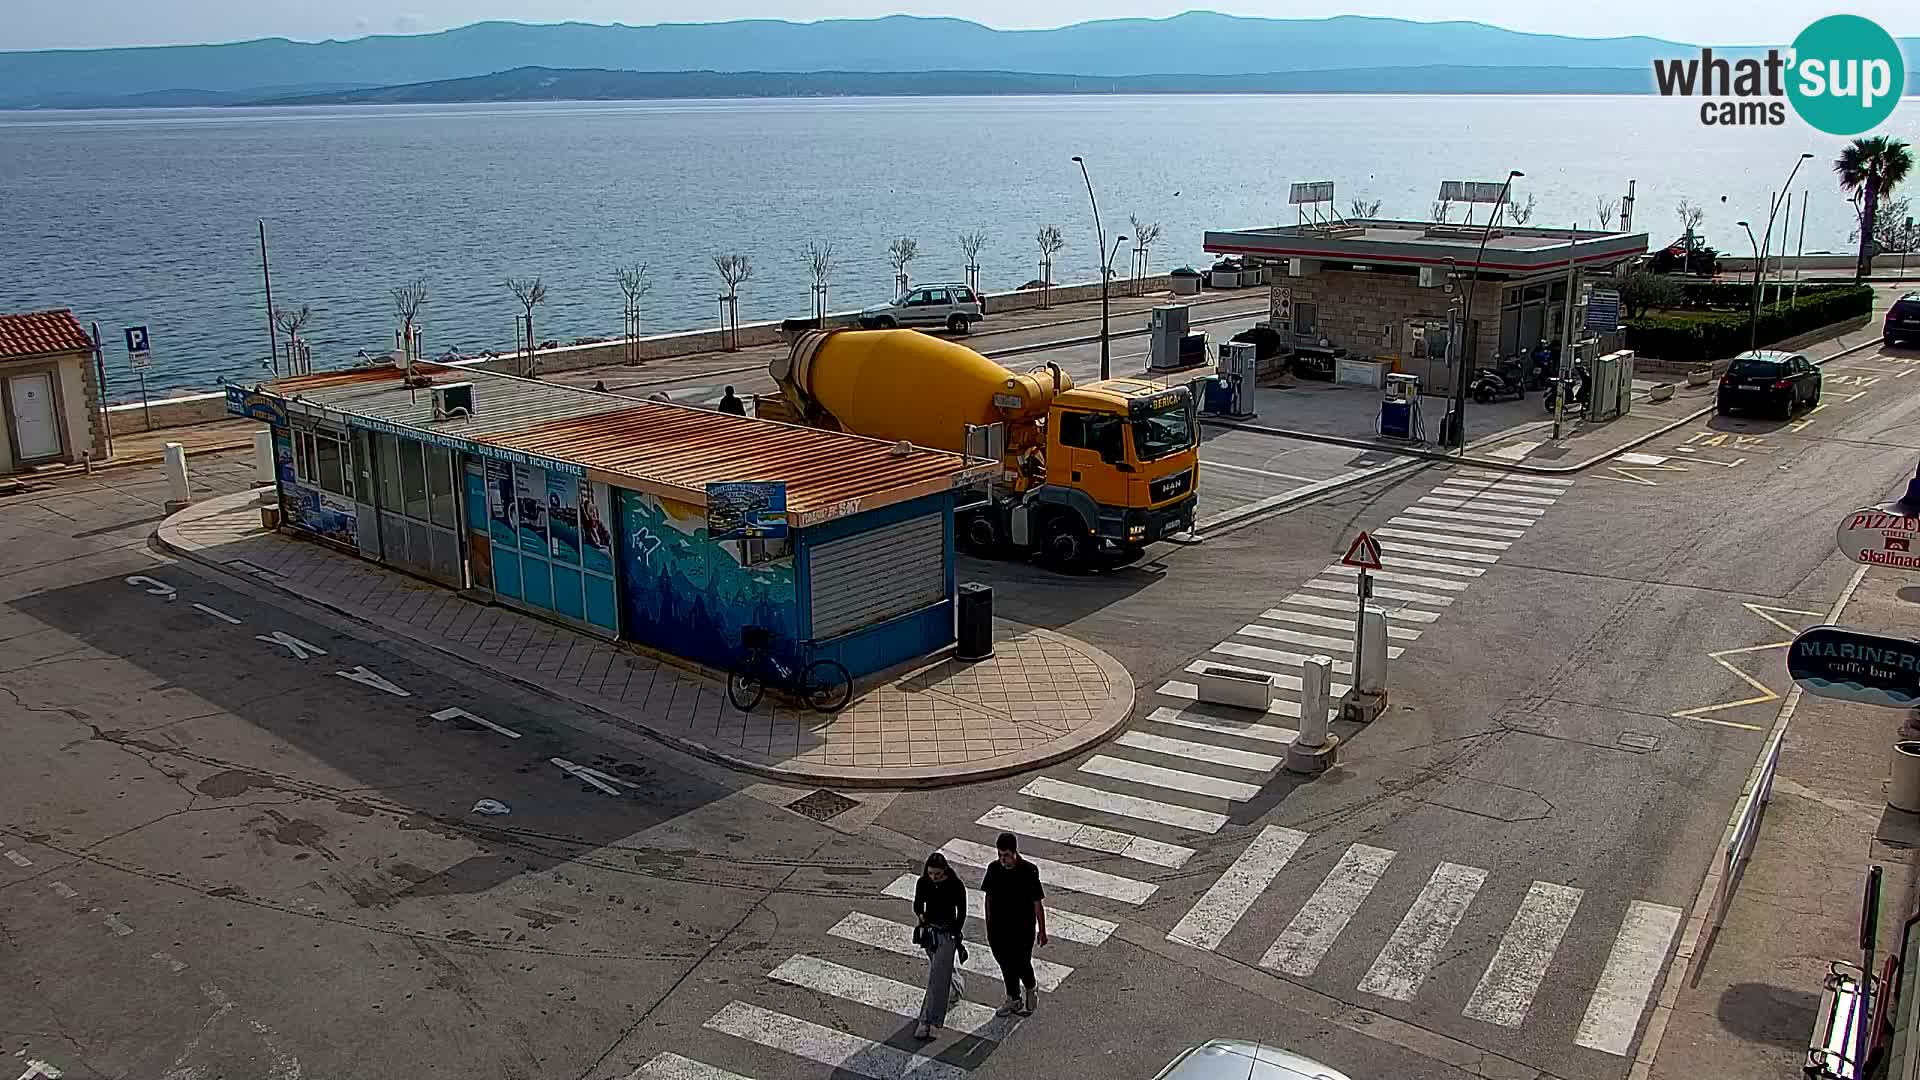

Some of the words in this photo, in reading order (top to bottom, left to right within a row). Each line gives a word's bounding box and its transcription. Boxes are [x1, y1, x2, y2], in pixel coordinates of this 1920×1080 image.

[131, 330, 143, 349] P
[1153, 395, 1179, 409] BERICA
[437, 436, 468, 450] POSTAJA
[478, 445, 494, 457] BUS
[494, 449, 526, 465] STATION
[528, 456, 554, 471] TICKET
[556, 462, 582, 477] OFFICE
[1162, 479, 1181, 492] MAN
[1848, 513, 1920, 532] PIZZE
[1881, 529, 1916, 540] GRILL
[1828, 662, 1863, 673] caffe
[1870, 665, 1896, 680] bar
